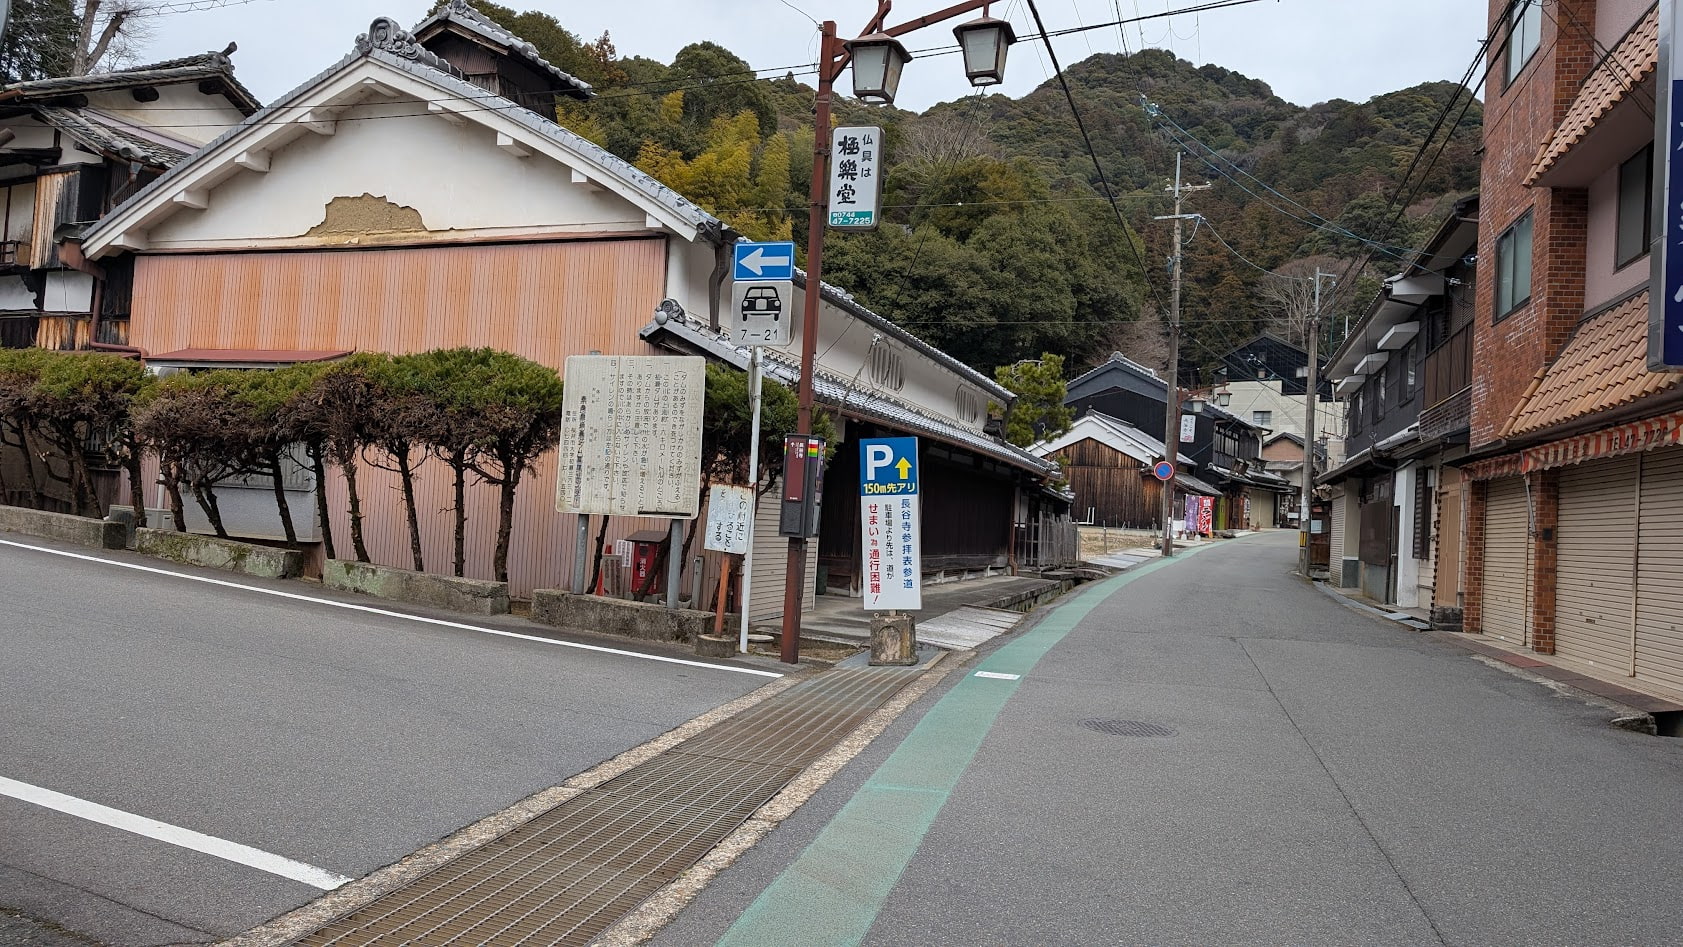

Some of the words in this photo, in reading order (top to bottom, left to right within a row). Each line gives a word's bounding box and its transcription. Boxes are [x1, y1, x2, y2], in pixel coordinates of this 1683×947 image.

[836, 135, 860, 205] 極樂堂
[860, 133, 873, 178] 仏具は
[832, 217, 871, 225] 47-7225
[866, 444, 894, 481] P
[863, 482, 916, 494] 150m先アリ
[901, 498, 914, 589] 長谷寺参拝表参道
